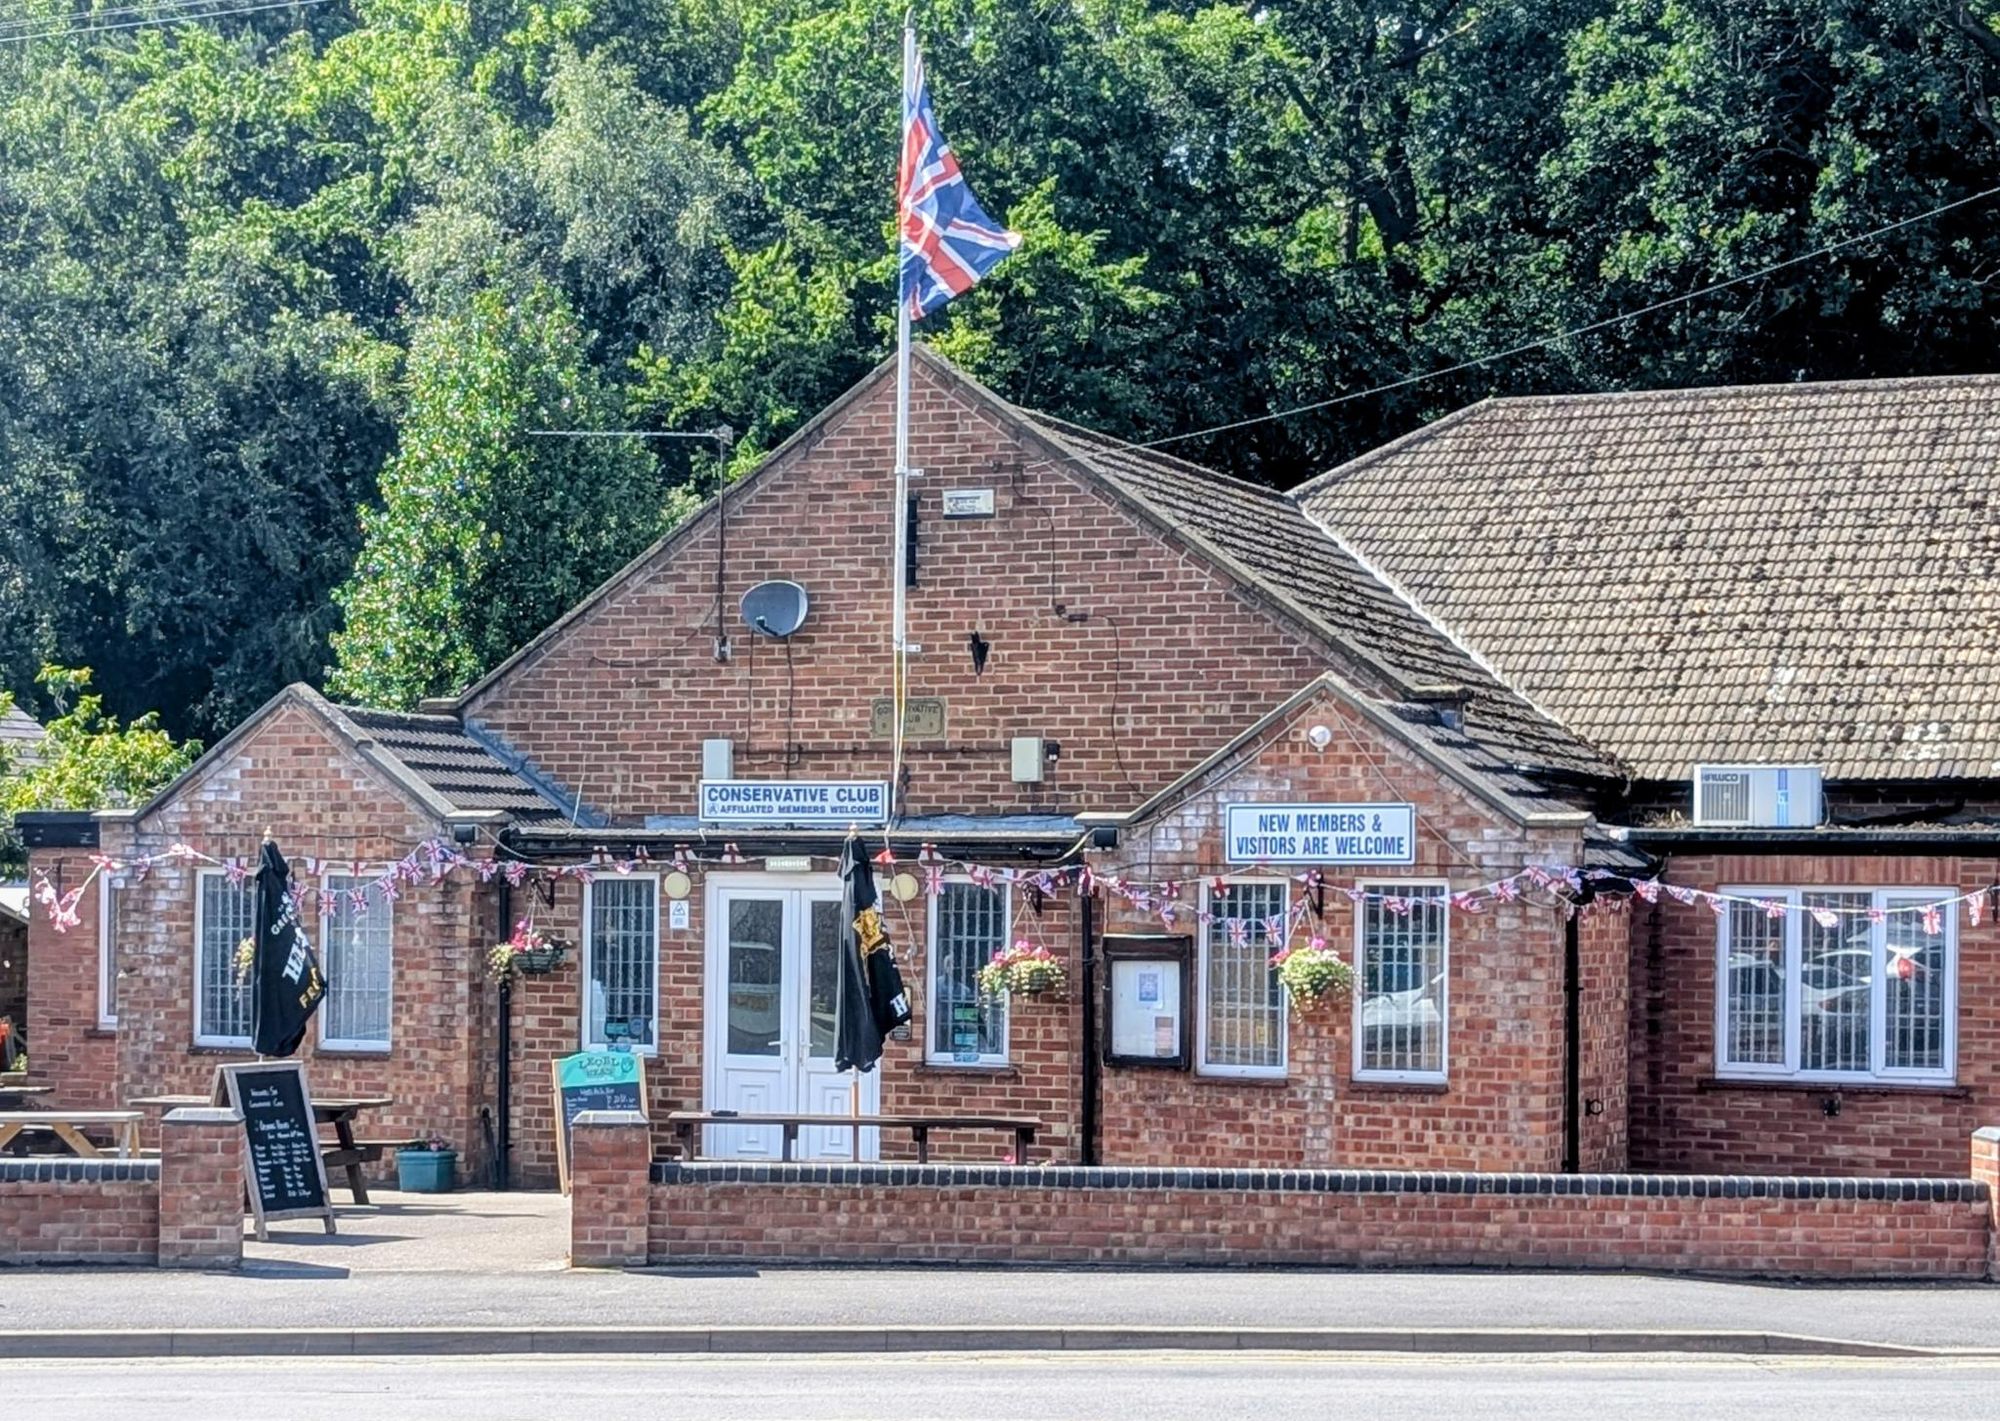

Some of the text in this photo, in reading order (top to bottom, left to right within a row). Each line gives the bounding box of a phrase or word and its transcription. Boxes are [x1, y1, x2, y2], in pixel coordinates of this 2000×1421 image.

[708, 787, 879, 802] CONSERVATIVE CLUB
[720, 805, 879, 814] AFFILIATED MEMBERS WELCOME
[1259, 814, 1382, 832] NEW MEMBERS &
[1236, 837, 1405, 855] VISITORS ARE WELCOME
